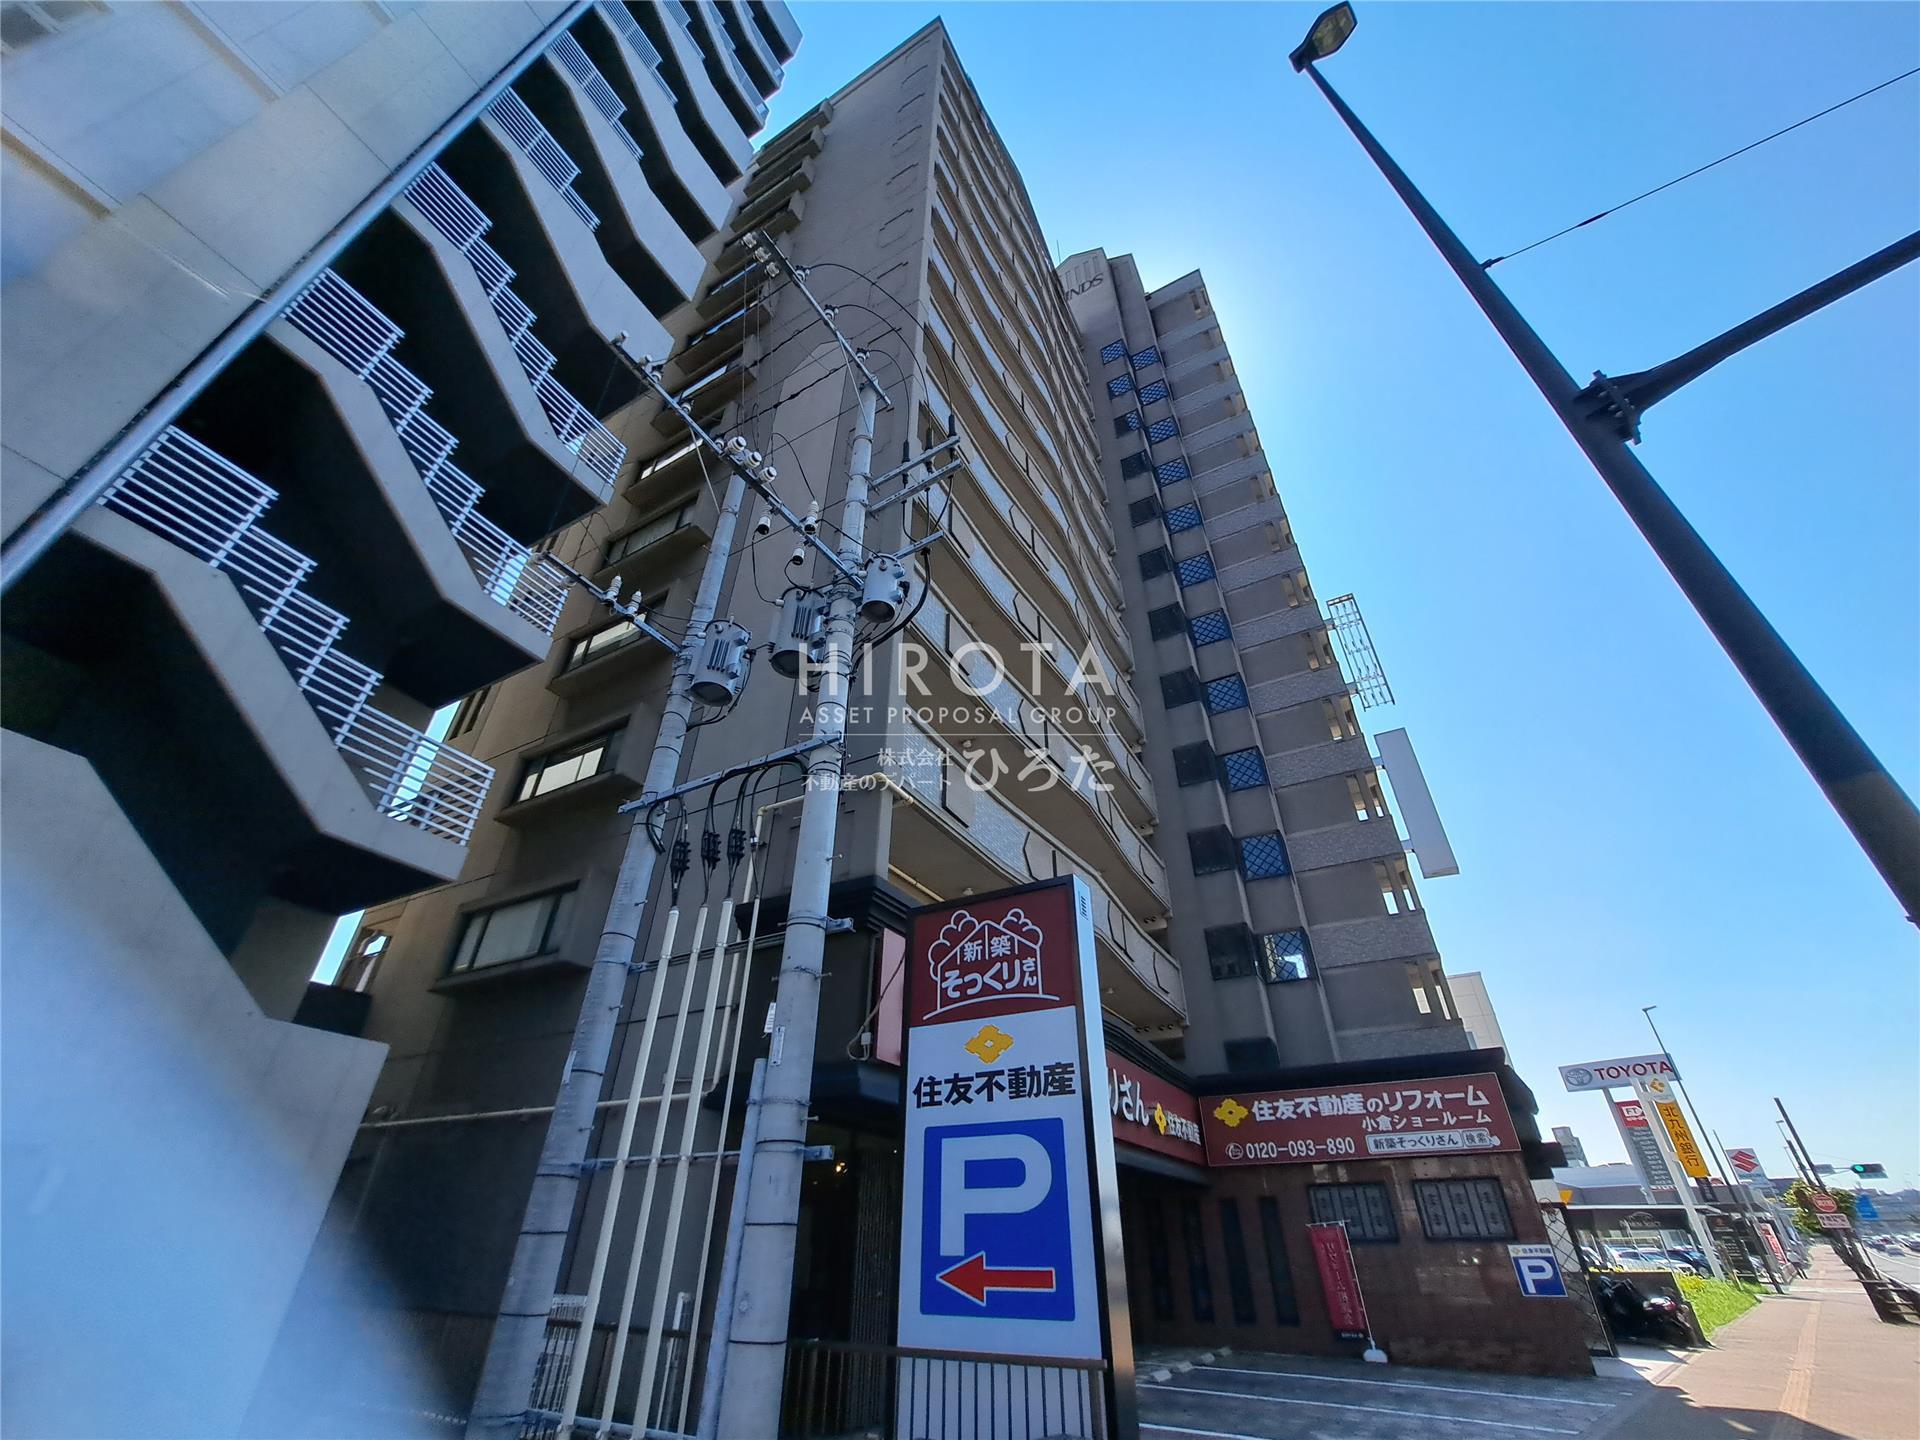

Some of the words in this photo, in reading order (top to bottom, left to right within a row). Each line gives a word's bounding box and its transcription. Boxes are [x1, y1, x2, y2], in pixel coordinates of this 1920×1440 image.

[963, 934, 1011, 962] 新築
[912, 1062, 1076, 1109] 住友不動産
[1594, 1062, 1674, 1080] TOYOTA
[1251, 1085, 1490, 1122] 住友不動産のリフォーム
[1362, 1109, 1492, 1132] 小倉ショールーム
[1662, 1105, 1700, 1167] 北九州銀行
[1245, 1136, 1355, 1158] 0120-093-890
[1373, 1134, 1458, 1150] 新築そっくりさん
[939, 1133, 1053, 1257] P
[1518, 1259, 1554, 1294] P
